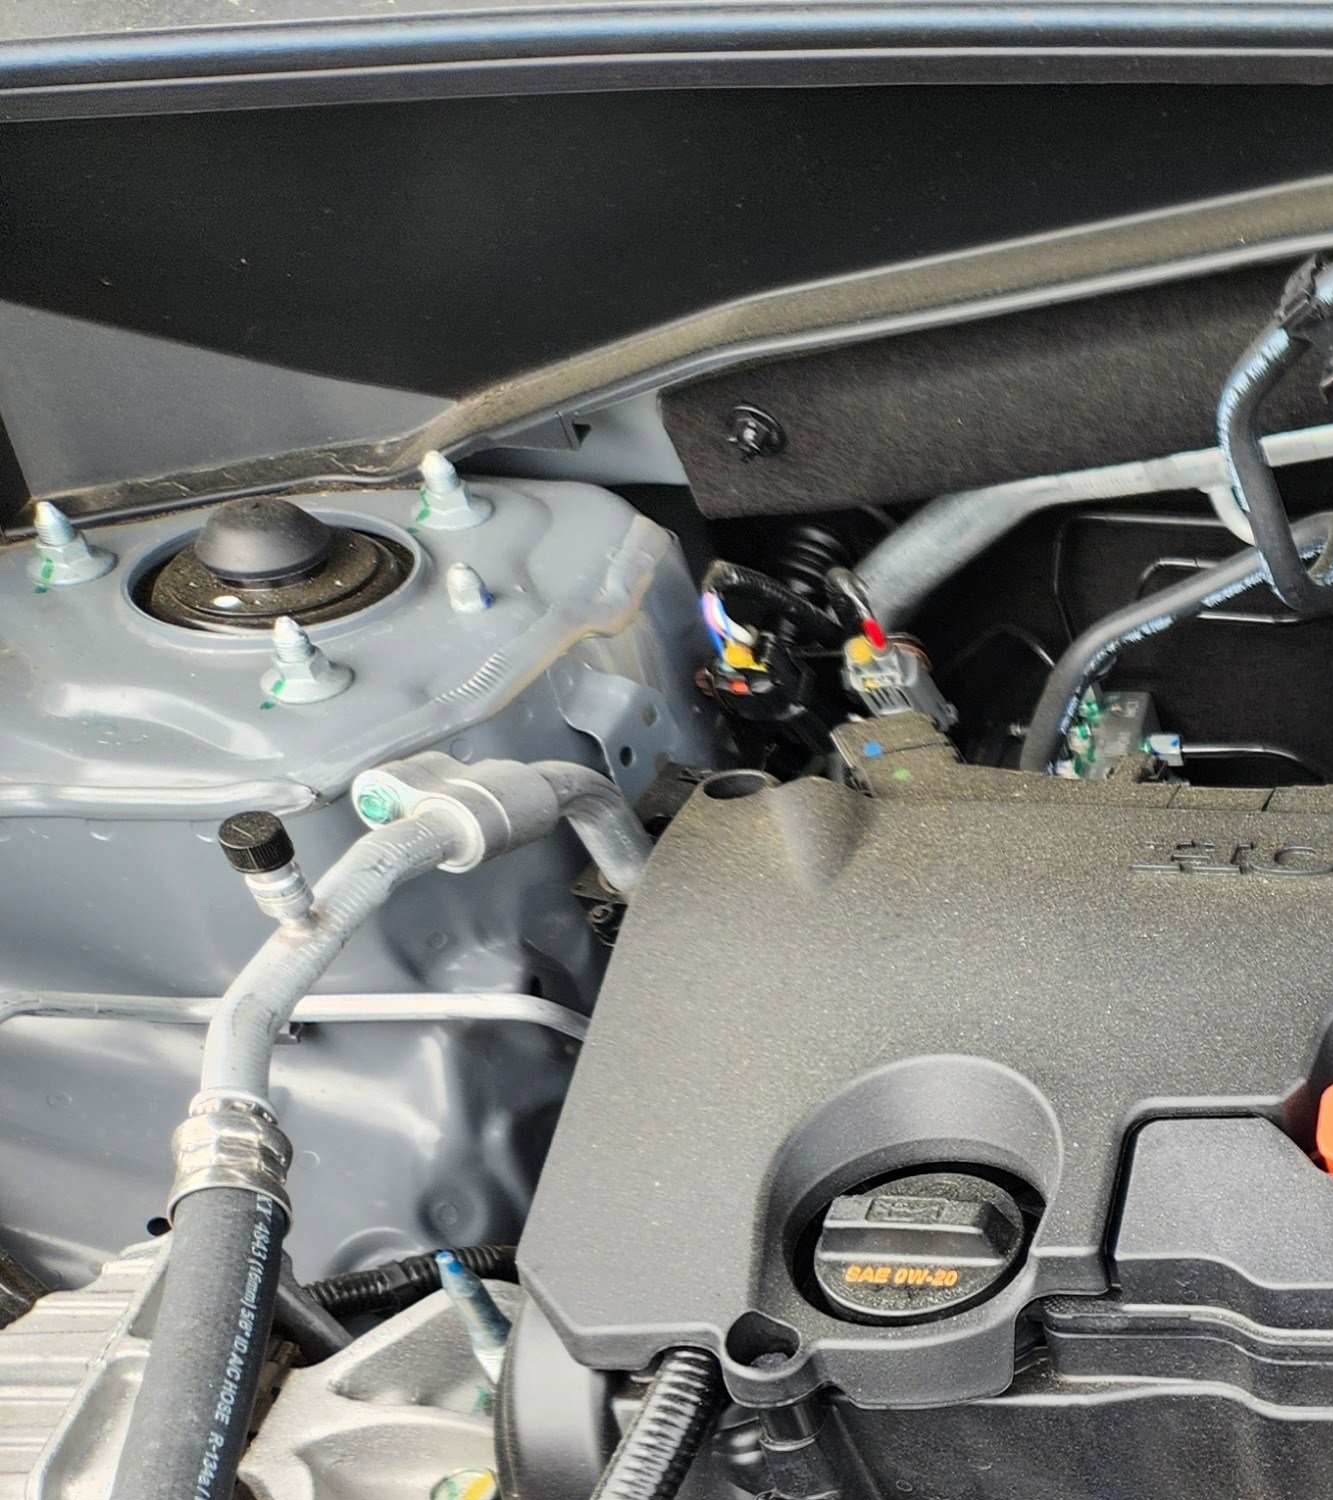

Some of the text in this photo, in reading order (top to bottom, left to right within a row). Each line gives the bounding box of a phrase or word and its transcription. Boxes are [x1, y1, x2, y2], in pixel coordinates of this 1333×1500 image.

[252, 1221, 270, 1261] 4843
[845, 1265, 959, 1287] SAE 0W-20
[226, 1352, 245, 1381] A/C
[214, 1379, 239, 1426] HOSE
